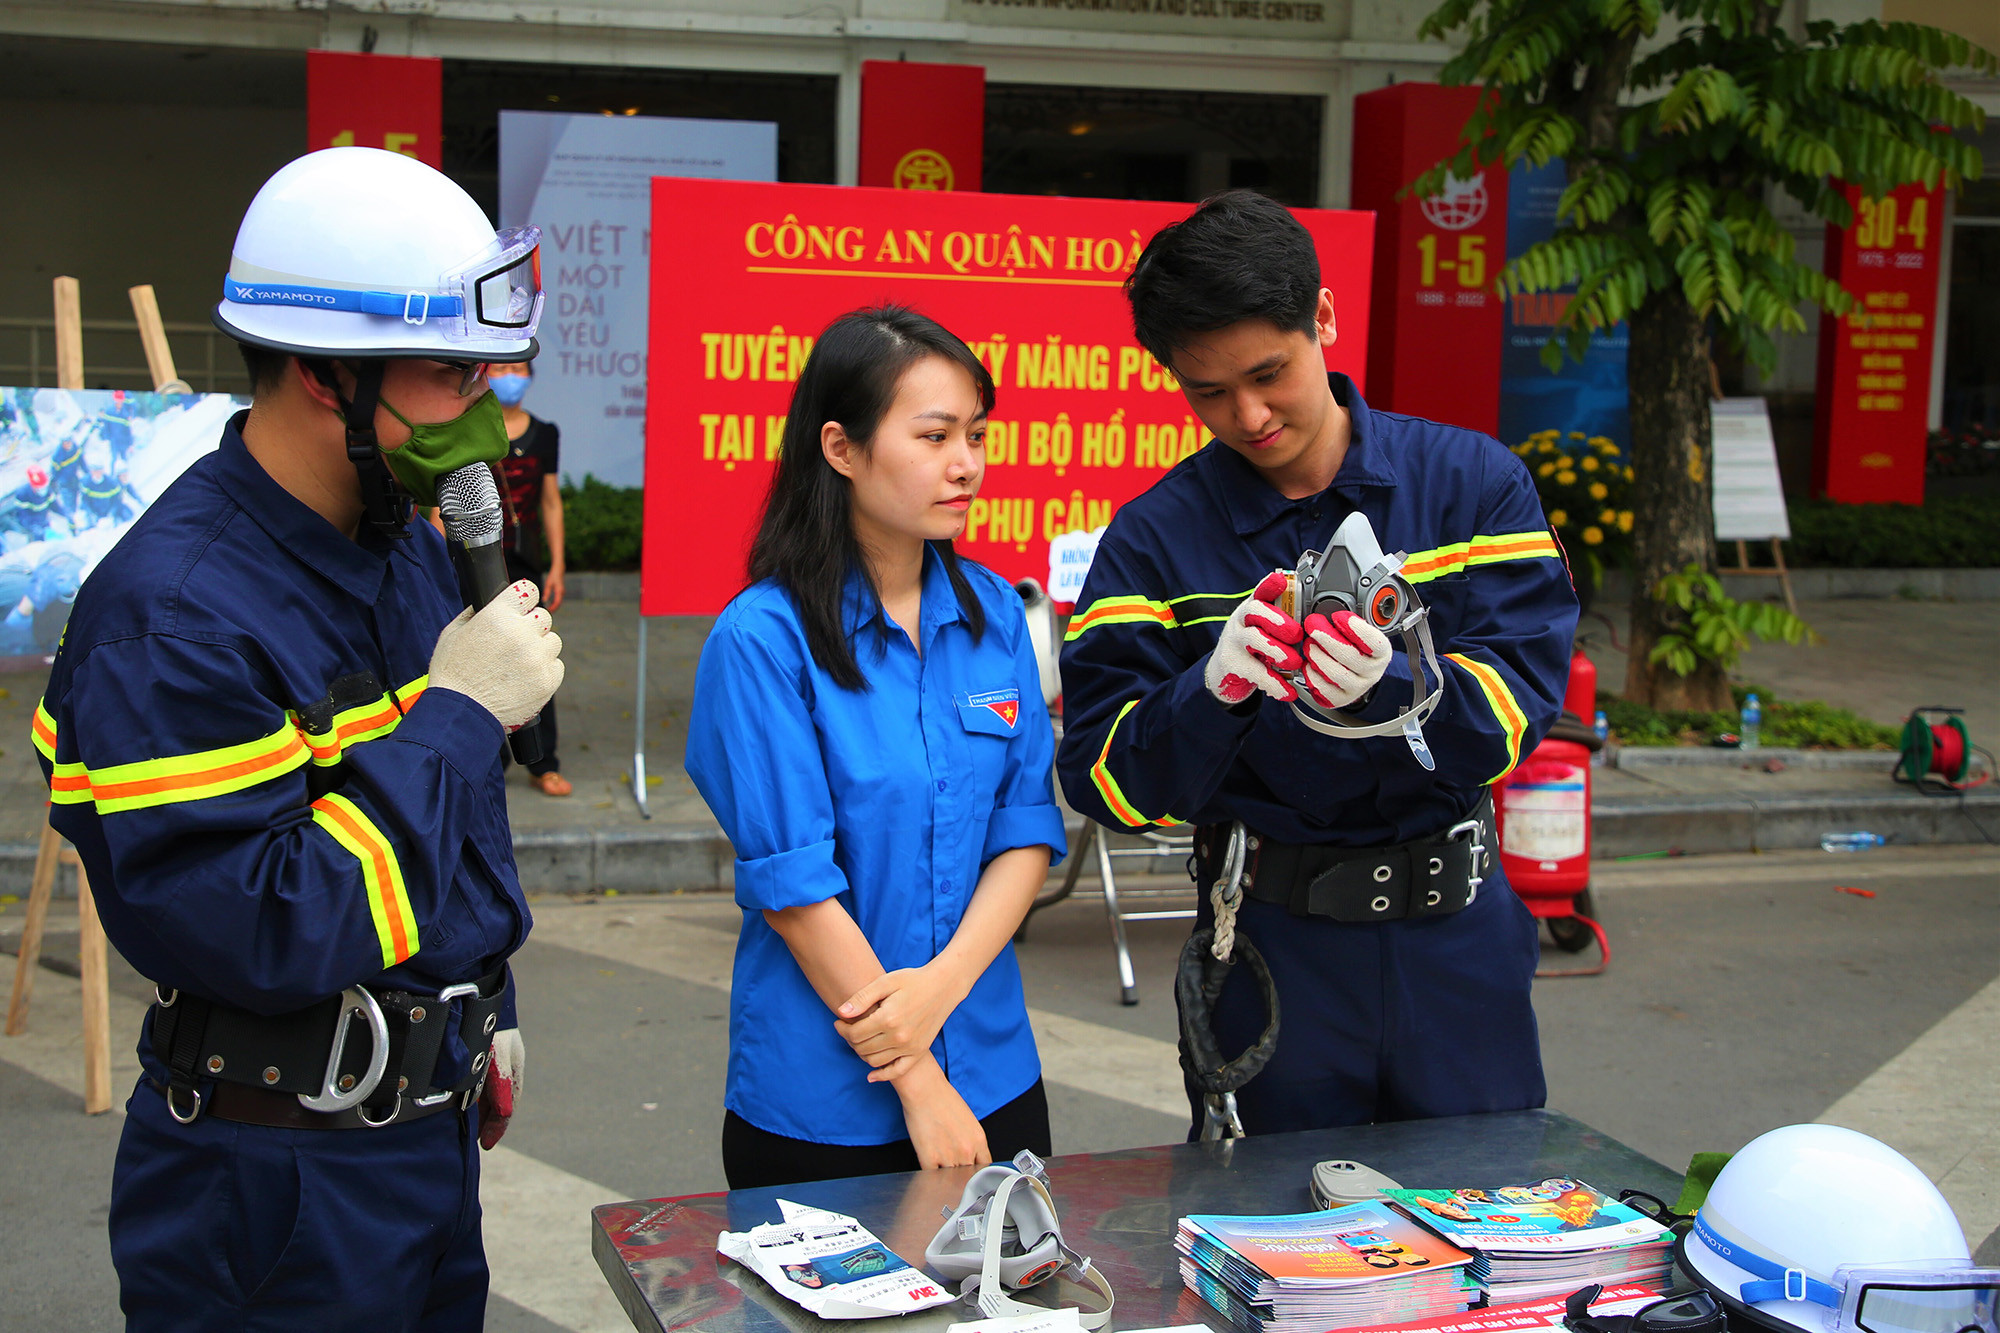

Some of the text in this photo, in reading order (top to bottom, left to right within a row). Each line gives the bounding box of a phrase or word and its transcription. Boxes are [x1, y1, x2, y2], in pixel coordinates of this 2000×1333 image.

[1190, 2, 1263, 19] CULTURE
[1264, 4, 1326, 22] CENTER
[550, 219, 628, 257] VIỆT
[1856, 195, 1929, 249] 30-4
[745, 214, 865, 262] CÔNG
[876, 229, 933, 264] AN
[942, 224, 1056, 277] QUẬN
[1417, 234, 1487, 287] 1-5
[255, 291, 336, 305] YAMAMOTO
[1456, 292, 1486, 307] 2022
[557, 321, 611, 348] YÊU
[558, 349, 647, 378] THƯƠ
[701, 325, 814, 382] TUYÊN
[1017, 335, 1110, 391] NĂNG
[700, 414, 755, 471] TẠI
[985, 420, 1019, 466] ĐI
[1028, 412, 1074, 477] BỘ
[1081, 408, 1127, 468] HỒ
[966, 498, 1035, 553] PHỤ
[1255, 1243, 1338, 1253] KIẾN THỨC
[908, 1286, 939, 1301] 3M
